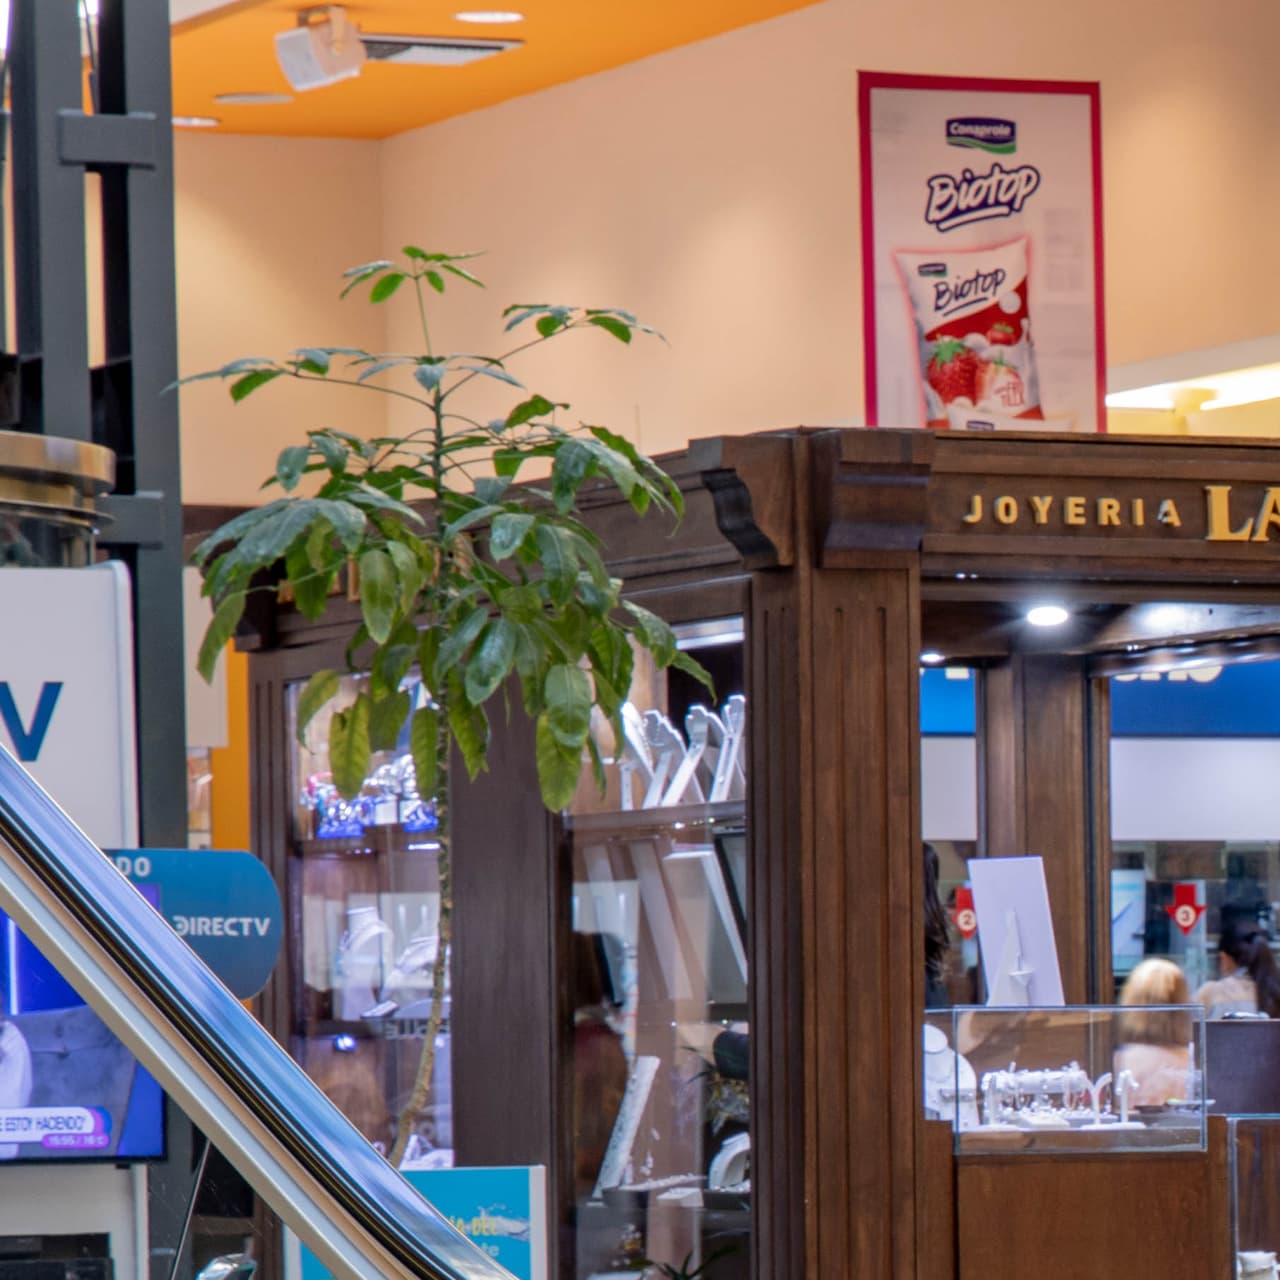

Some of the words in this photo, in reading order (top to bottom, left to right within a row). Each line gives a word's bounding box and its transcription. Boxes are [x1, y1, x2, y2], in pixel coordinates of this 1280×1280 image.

[950, 122, 1011, 138] Conaprole
[925, 163, 1040, 225] Biotop
[934, 268, 1005, 312] Biotop
[962, 495, 1182, 528] JOYERIA
[173, 916, 271, 936] DIRECTV
